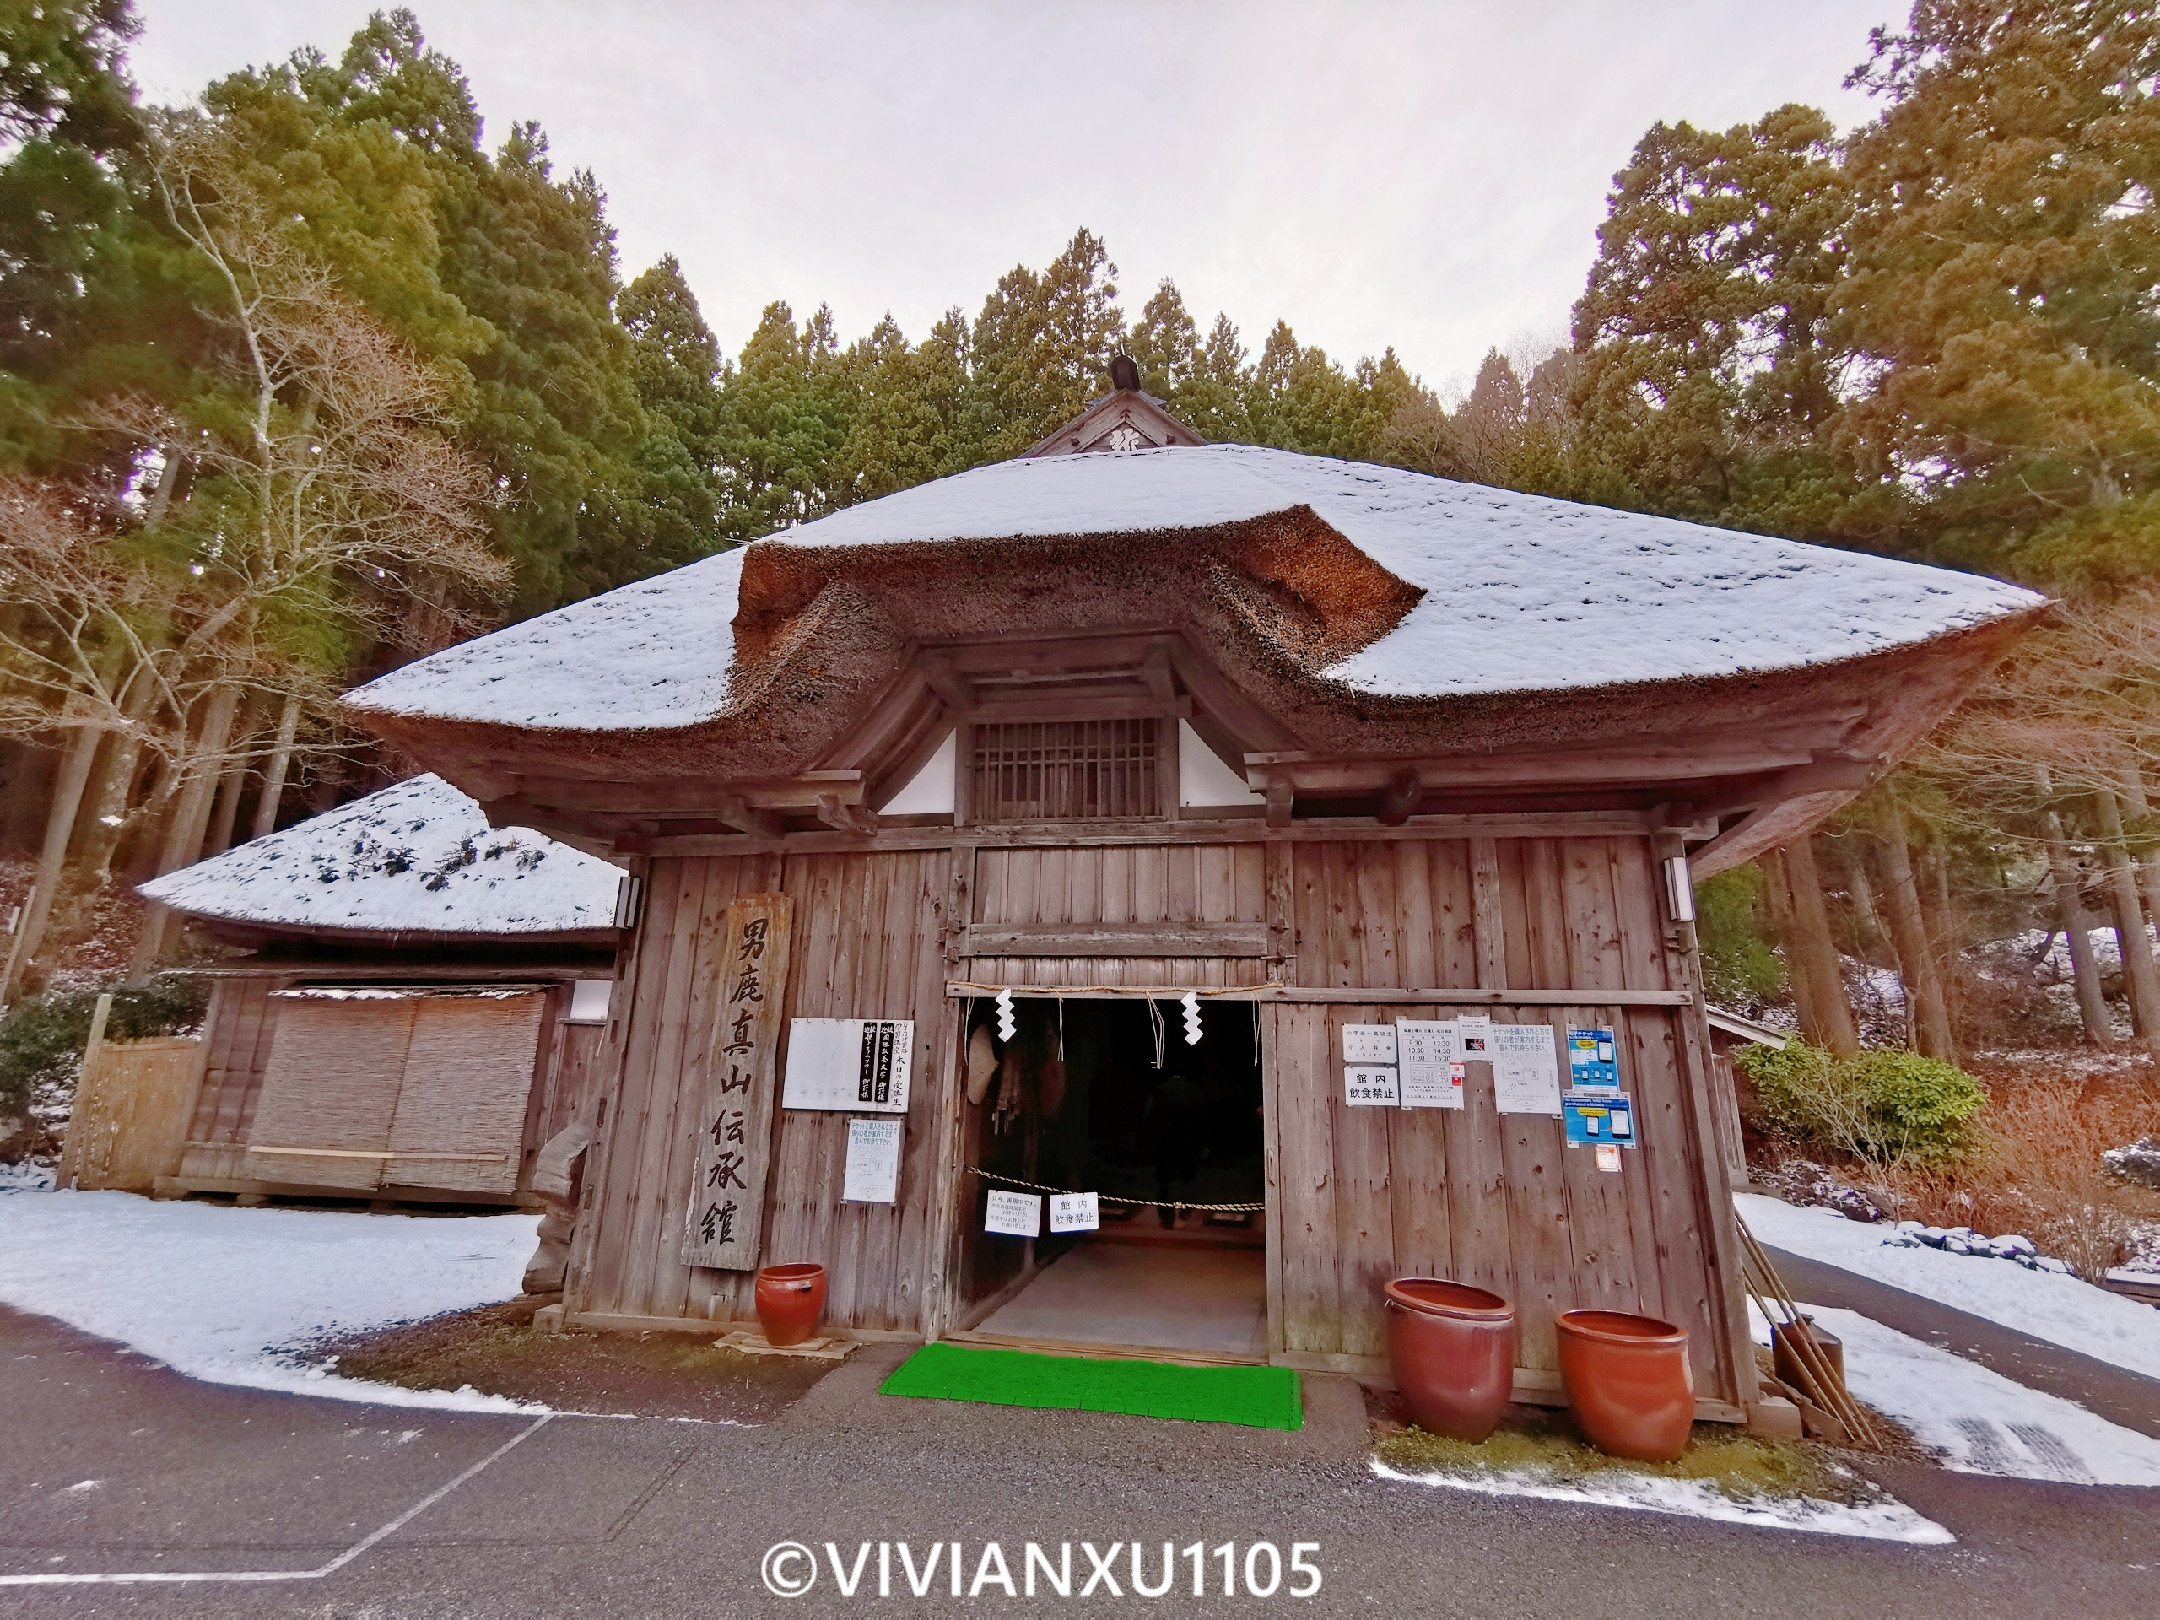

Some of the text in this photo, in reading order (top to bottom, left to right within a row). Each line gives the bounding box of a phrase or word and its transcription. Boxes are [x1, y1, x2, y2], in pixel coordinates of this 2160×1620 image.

[701, 917, 769, 1246] 男鹿真山伝承館
[1349, 1087, 1395, 1099] 飲食禁止
[1055, 1211, 1095, 1225] 飲食禁止
